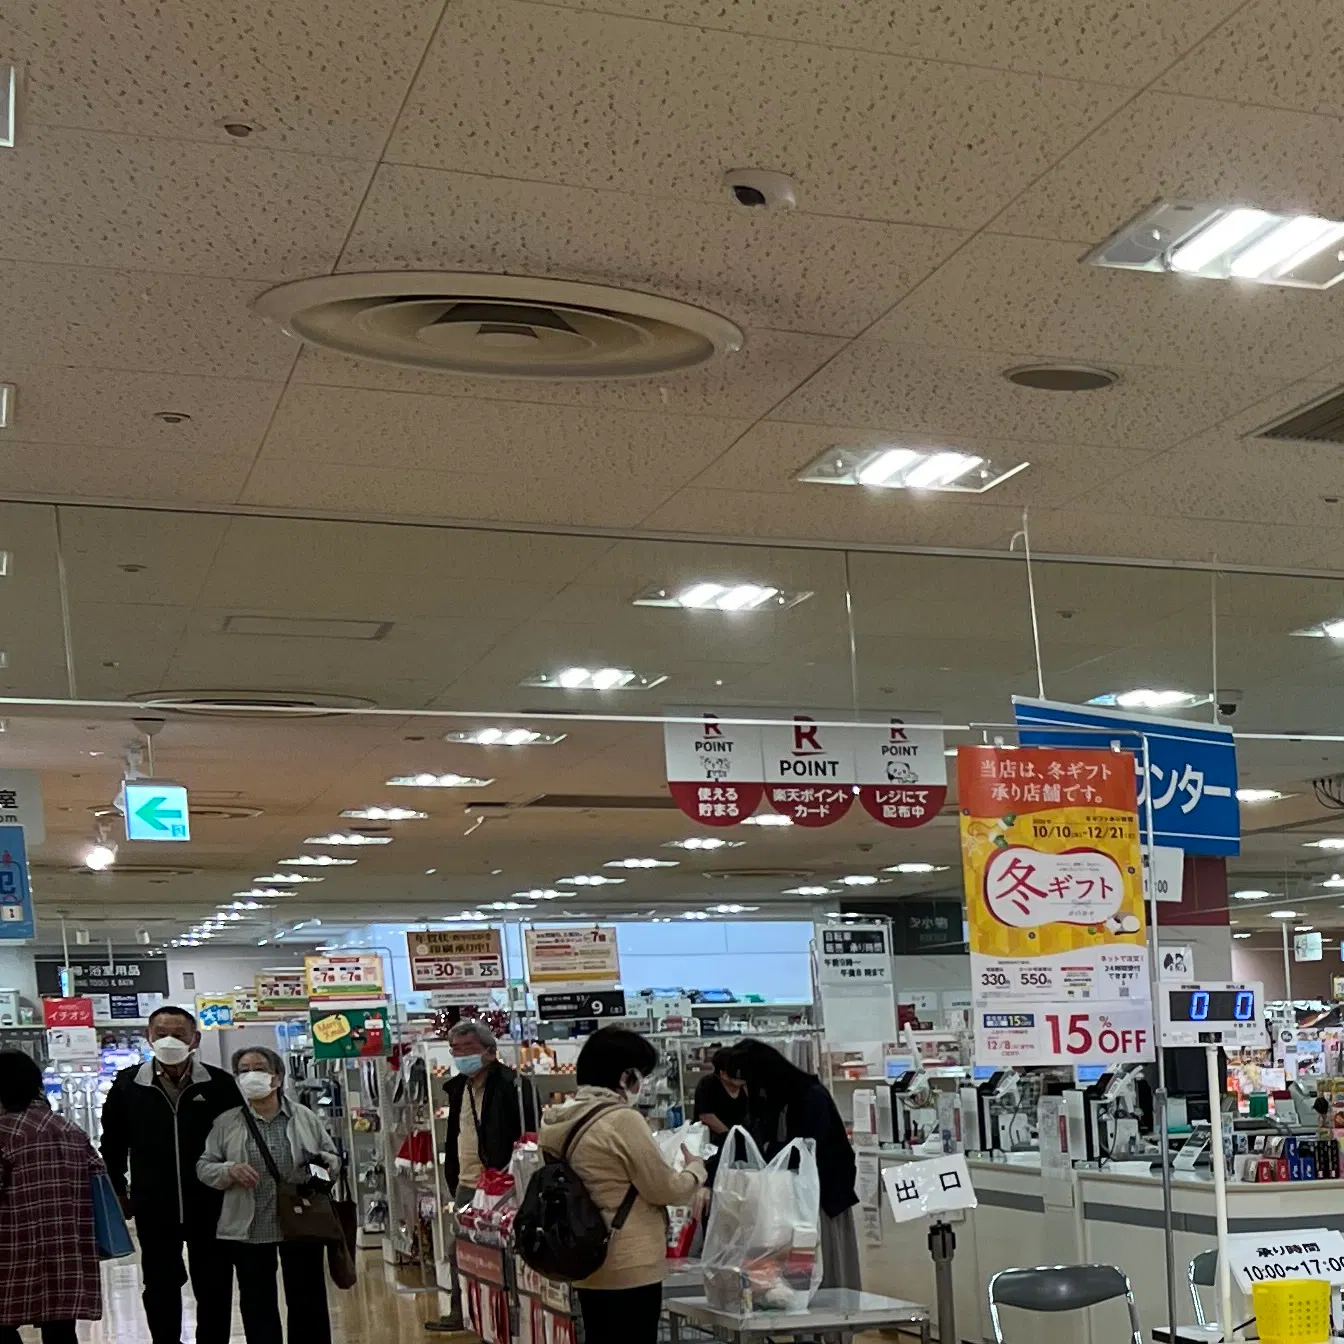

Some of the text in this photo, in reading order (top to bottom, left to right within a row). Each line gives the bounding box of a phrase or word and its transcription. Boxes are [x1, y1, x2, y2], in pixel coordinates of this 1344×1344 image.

[695, 741, 734, 752] POINT
[881, 745, 918, 756] POINT
[780, 760, 839, 777] POINT
[980, 760, 1112, 780] 当店は、冬ギフト
[698, 787, 739, 801] 使える
[773, 788, 848, 802] 楽天ポイント
[876, 789, 928, 803] レジにて
[990, 784, 1103, 804] 承り店舗です。
[698, 803, 739, 817] 貯まる
[795, 805, 830, 818] カード
[883, 805, 925, 819] 配布中
[995, 857, 1114, 916] 冬ギフト
[1189, 991, 1254, 1021] 0 0
[1045, 1013, 1147, 1055] 15 % OFF
